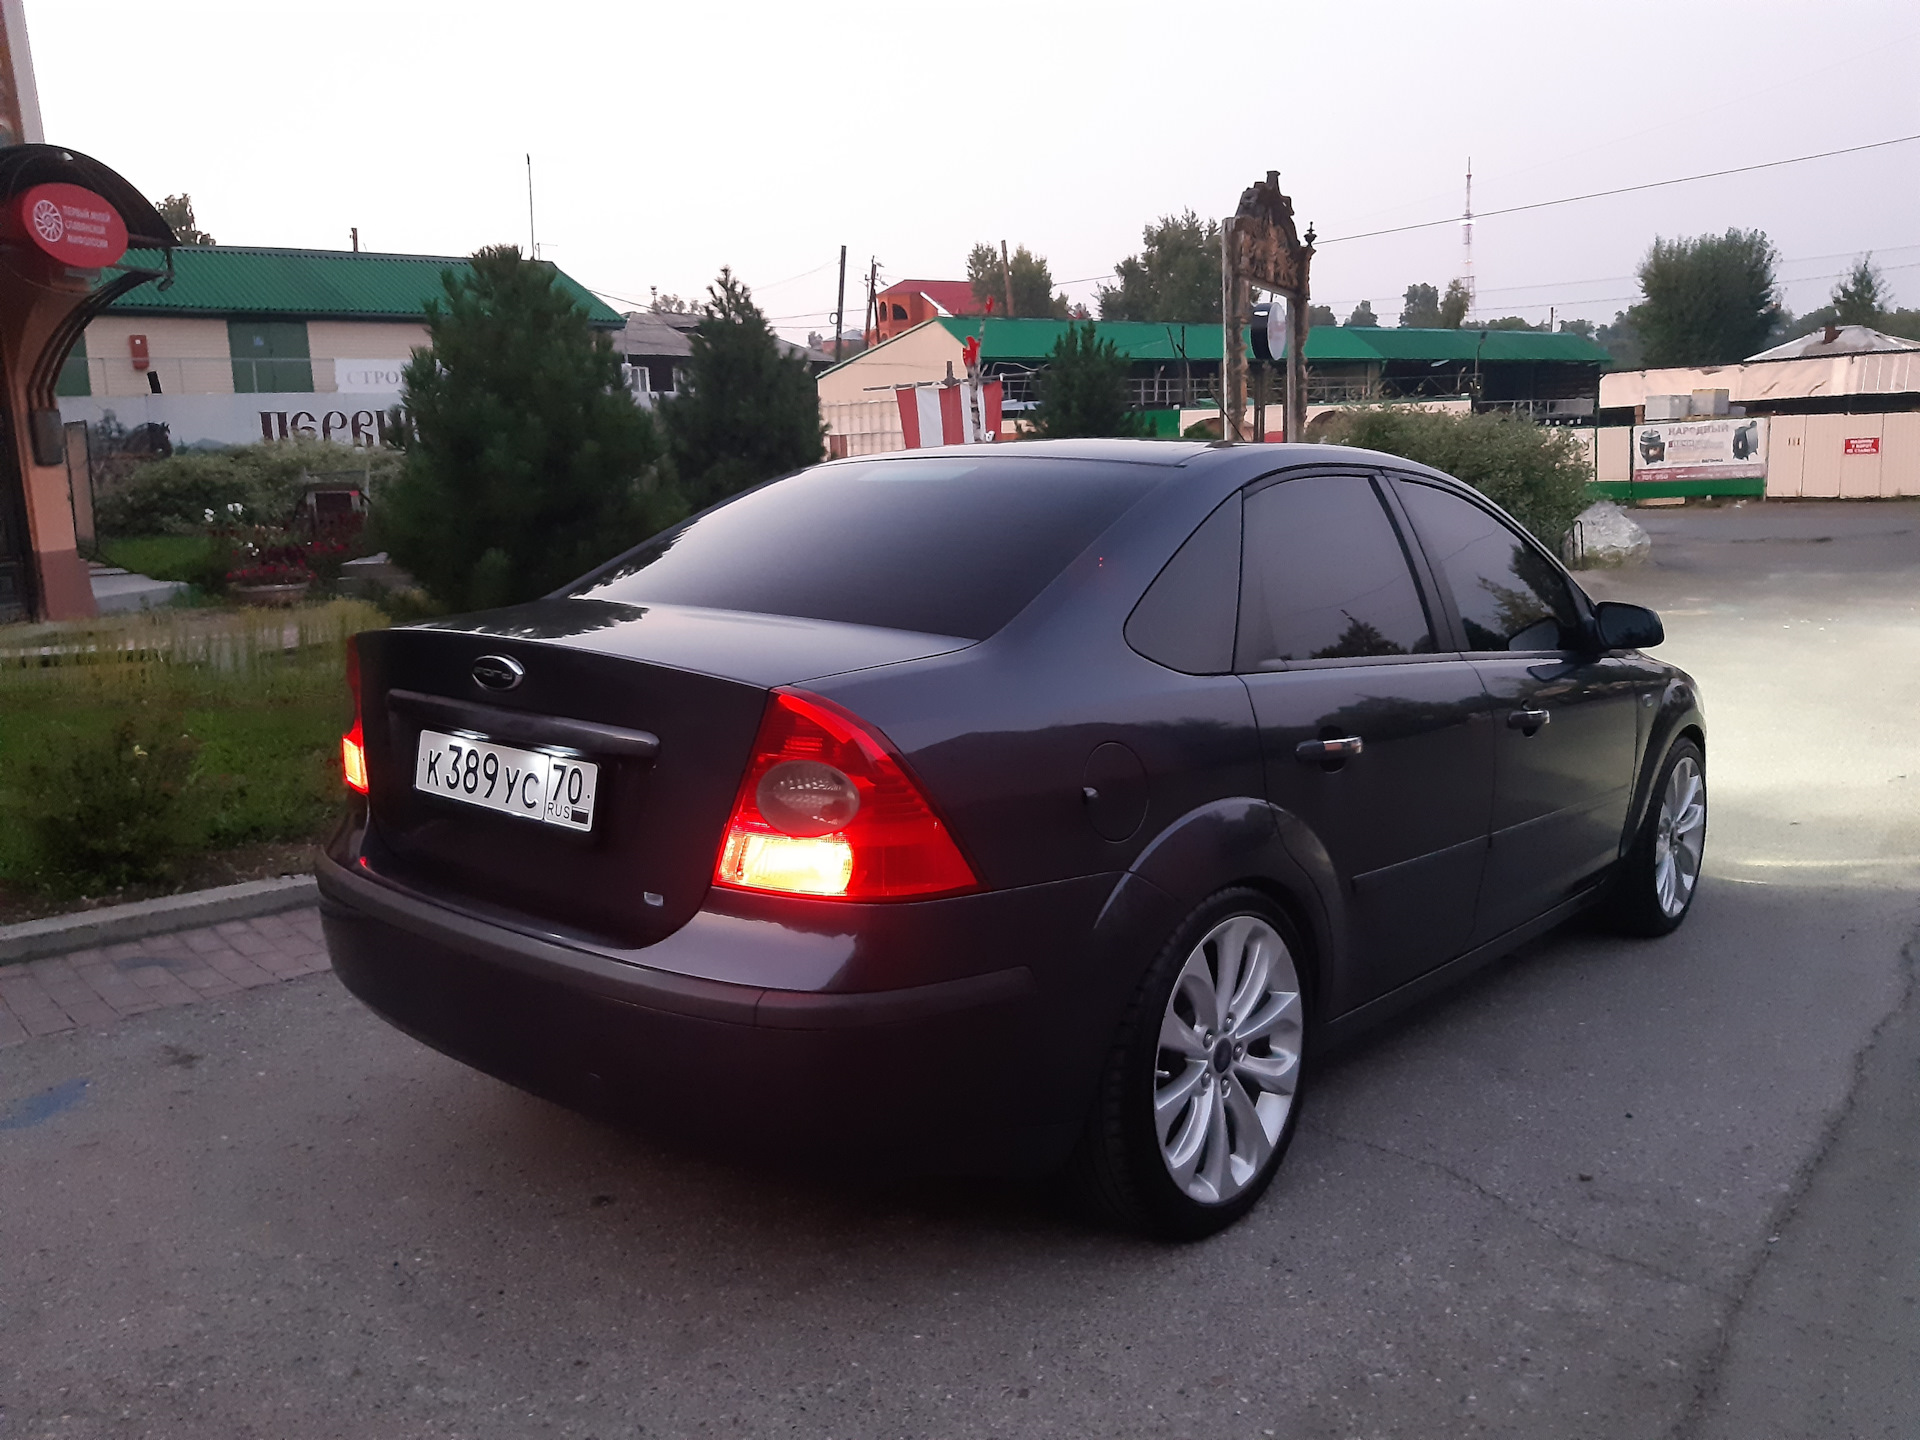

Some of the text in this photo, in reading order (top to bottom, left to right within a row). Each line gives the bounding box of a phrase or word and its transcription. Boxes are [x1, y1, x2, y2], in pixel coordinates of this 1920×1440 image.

[347, 370, 405, 385] СТРО
[1668, 424, 1729, 436] НАРОДНЫЙ
[552, 764, 584, 805] 70
[547, 801, 571, 819] RUS
